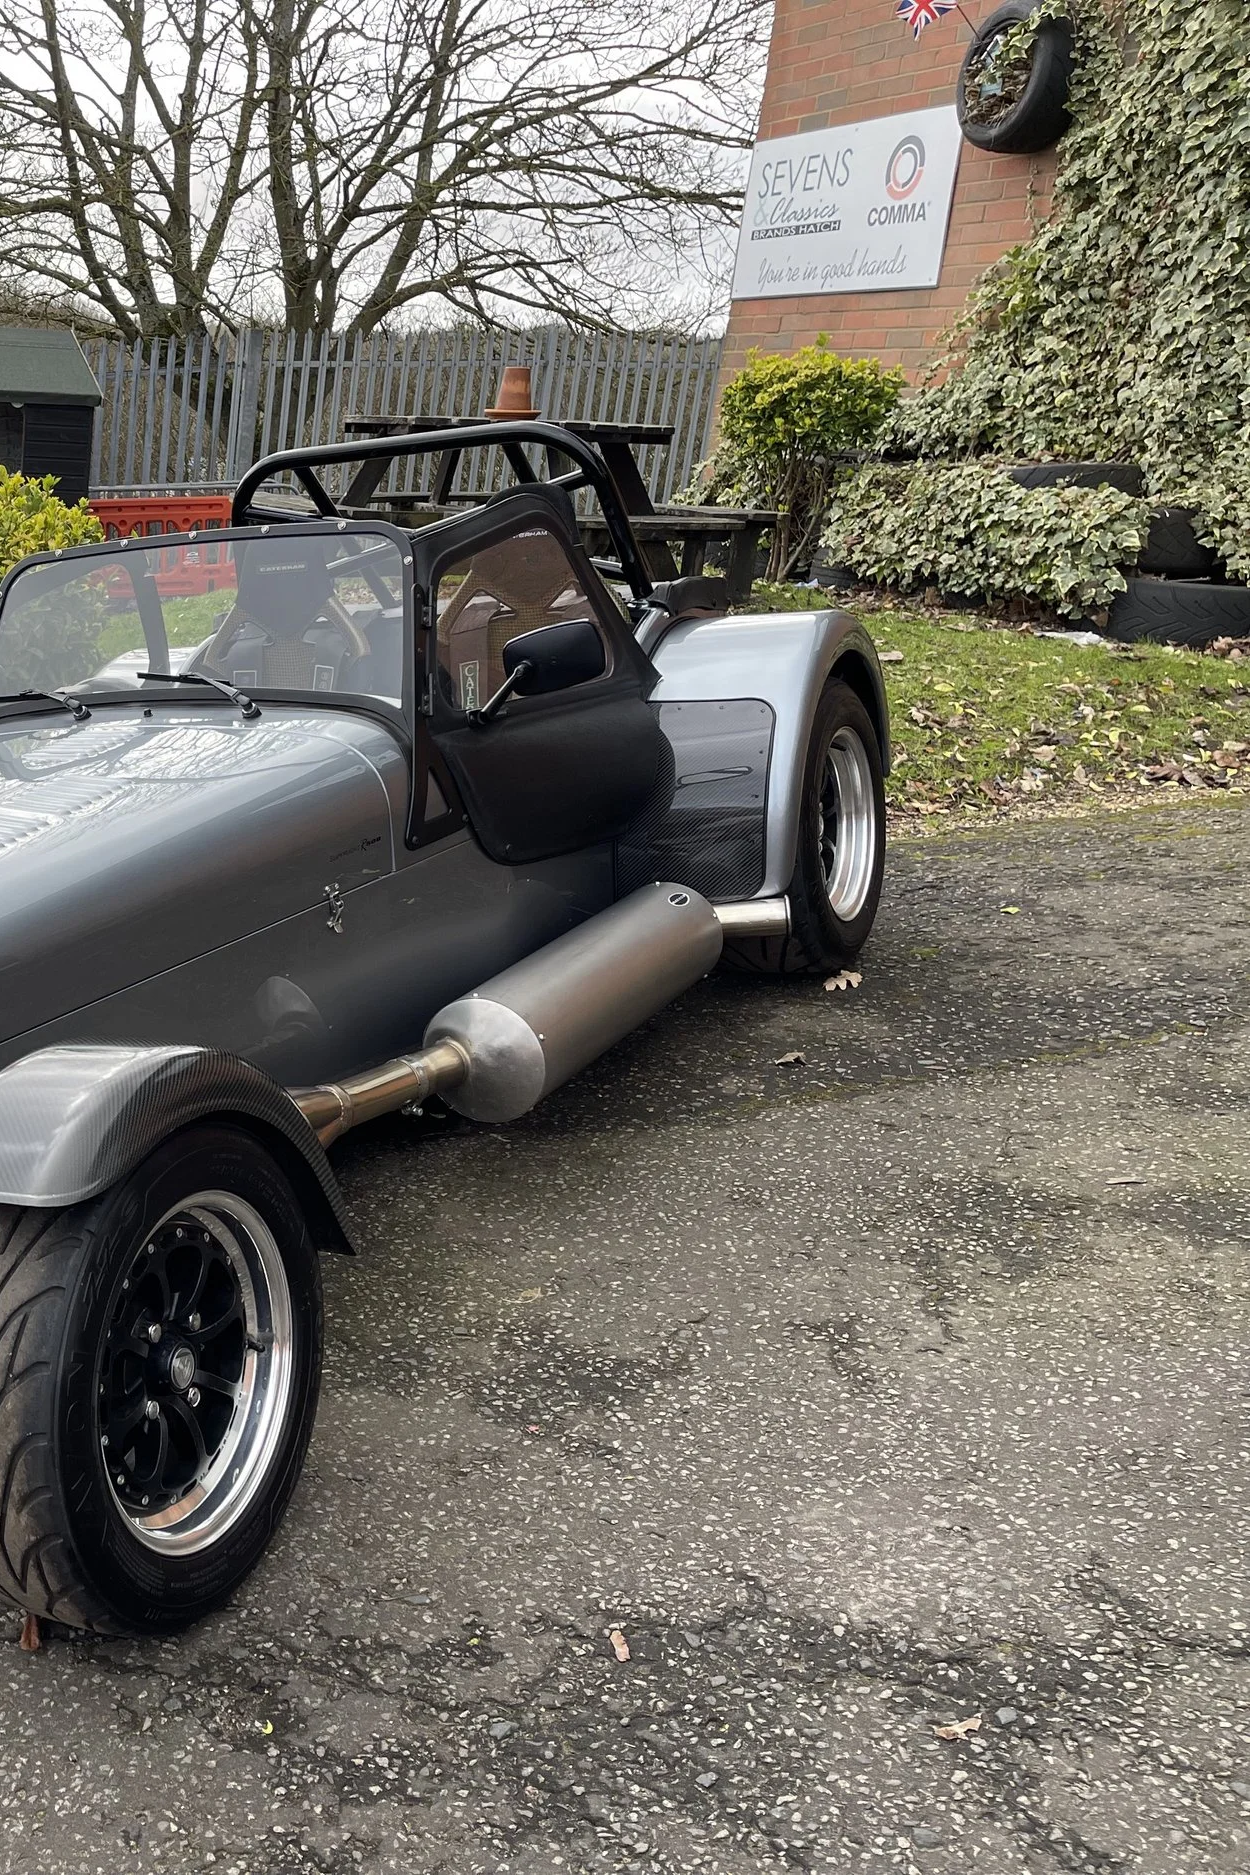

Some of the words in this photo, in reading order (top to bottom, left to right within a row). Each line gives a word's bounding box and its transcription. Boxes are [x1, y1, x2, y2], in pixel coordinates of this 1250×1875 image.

[758, 148, 854, 199] SEVENS
[770, 198, 839, 226] Classics
[867, 206, 926, 227] COMMA
[753, 225, 796, 240] BRANDS
[799, 220, 840, 235] HATCH
[757, 256, 800, 292] You're
[803, 259, 818, 282] in
[821, 249, 858, 290] good
[857, 244, 907, 277] hands
[259, 564, 305, 572] CATERHAM
[465, 664, 475, 709] CATE
